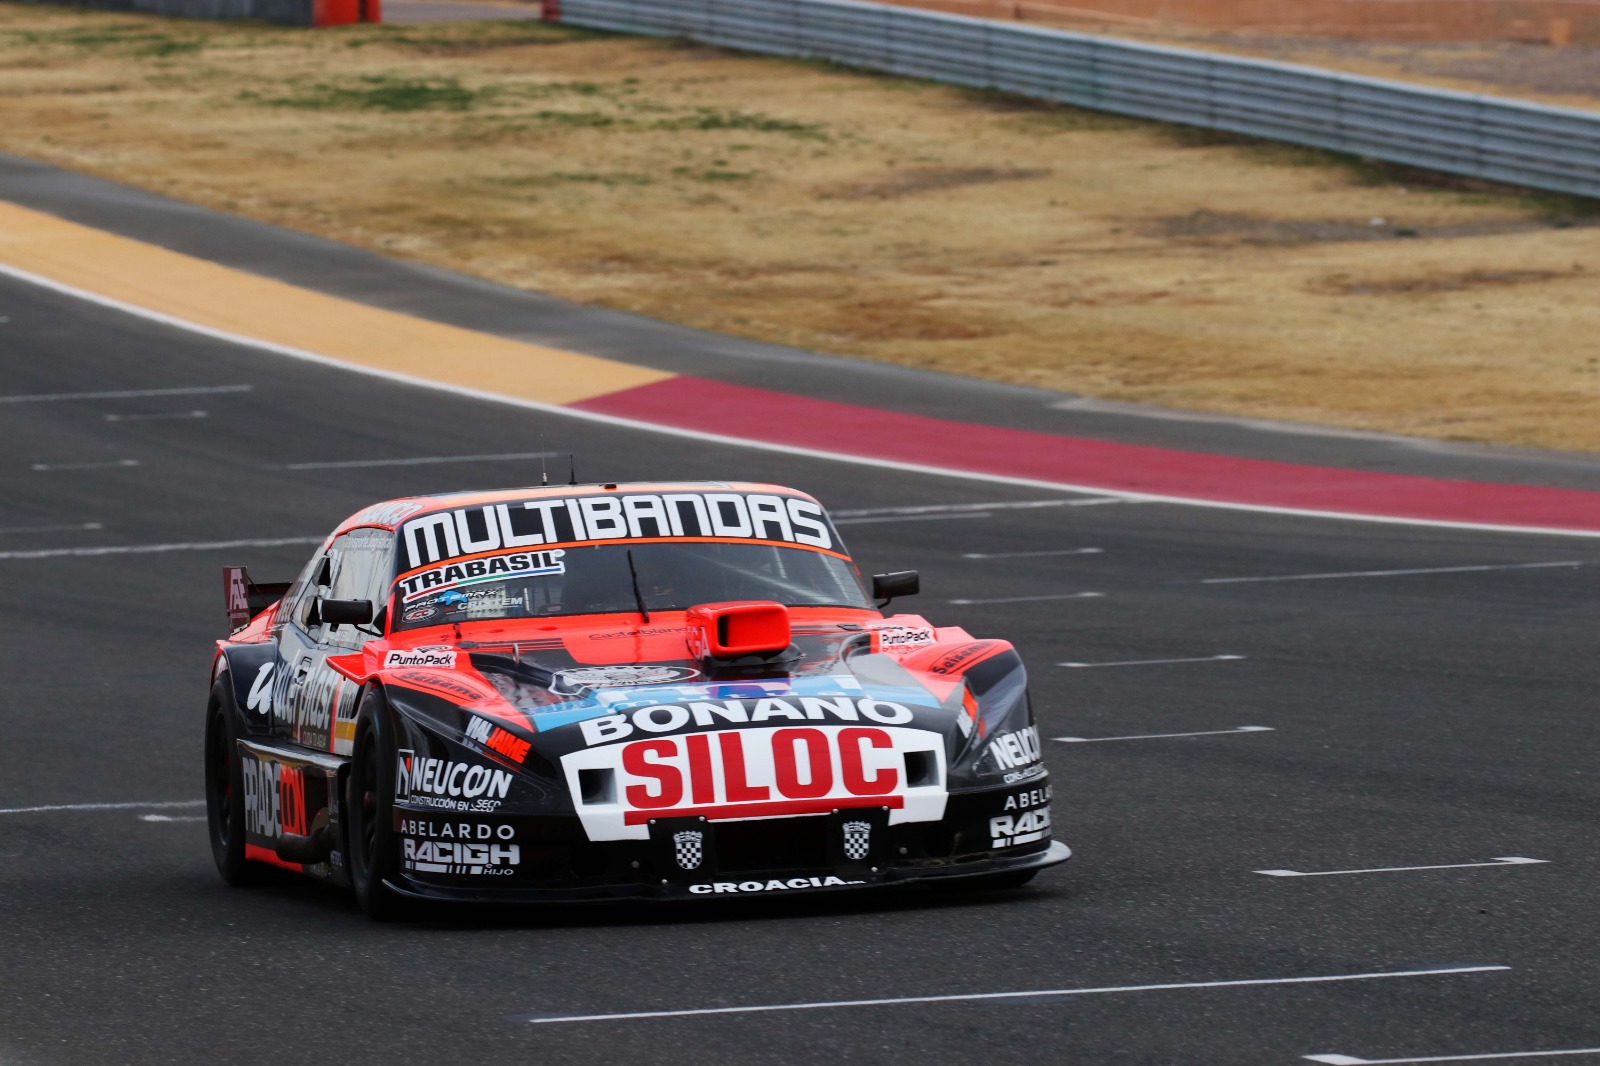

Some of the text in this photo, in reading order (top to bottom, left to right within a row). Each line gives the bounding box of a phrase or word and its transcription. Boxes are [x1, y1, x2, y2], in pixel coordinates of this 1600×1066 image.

[403, 493, 832, 569] MULTIBANDAS
[402, 553, 560, 595] TRABASIL
[882, 629, 930, 645] PuntoPack
[388, 653, 453, 666] PuntoPack
[578, 697, 914, 746] BONANO
[411, 756, 514, 799] NEUCON
[622, 727, 898, 809] SILOC
[457, 801, 469, 811] EN
[400, 818, 515, 840] ABELARDO
[403, 838, 521, 866] RACIGH
[483, 868, 514, 876] HIJO
[688, 875, 848, 894] CROACIA
